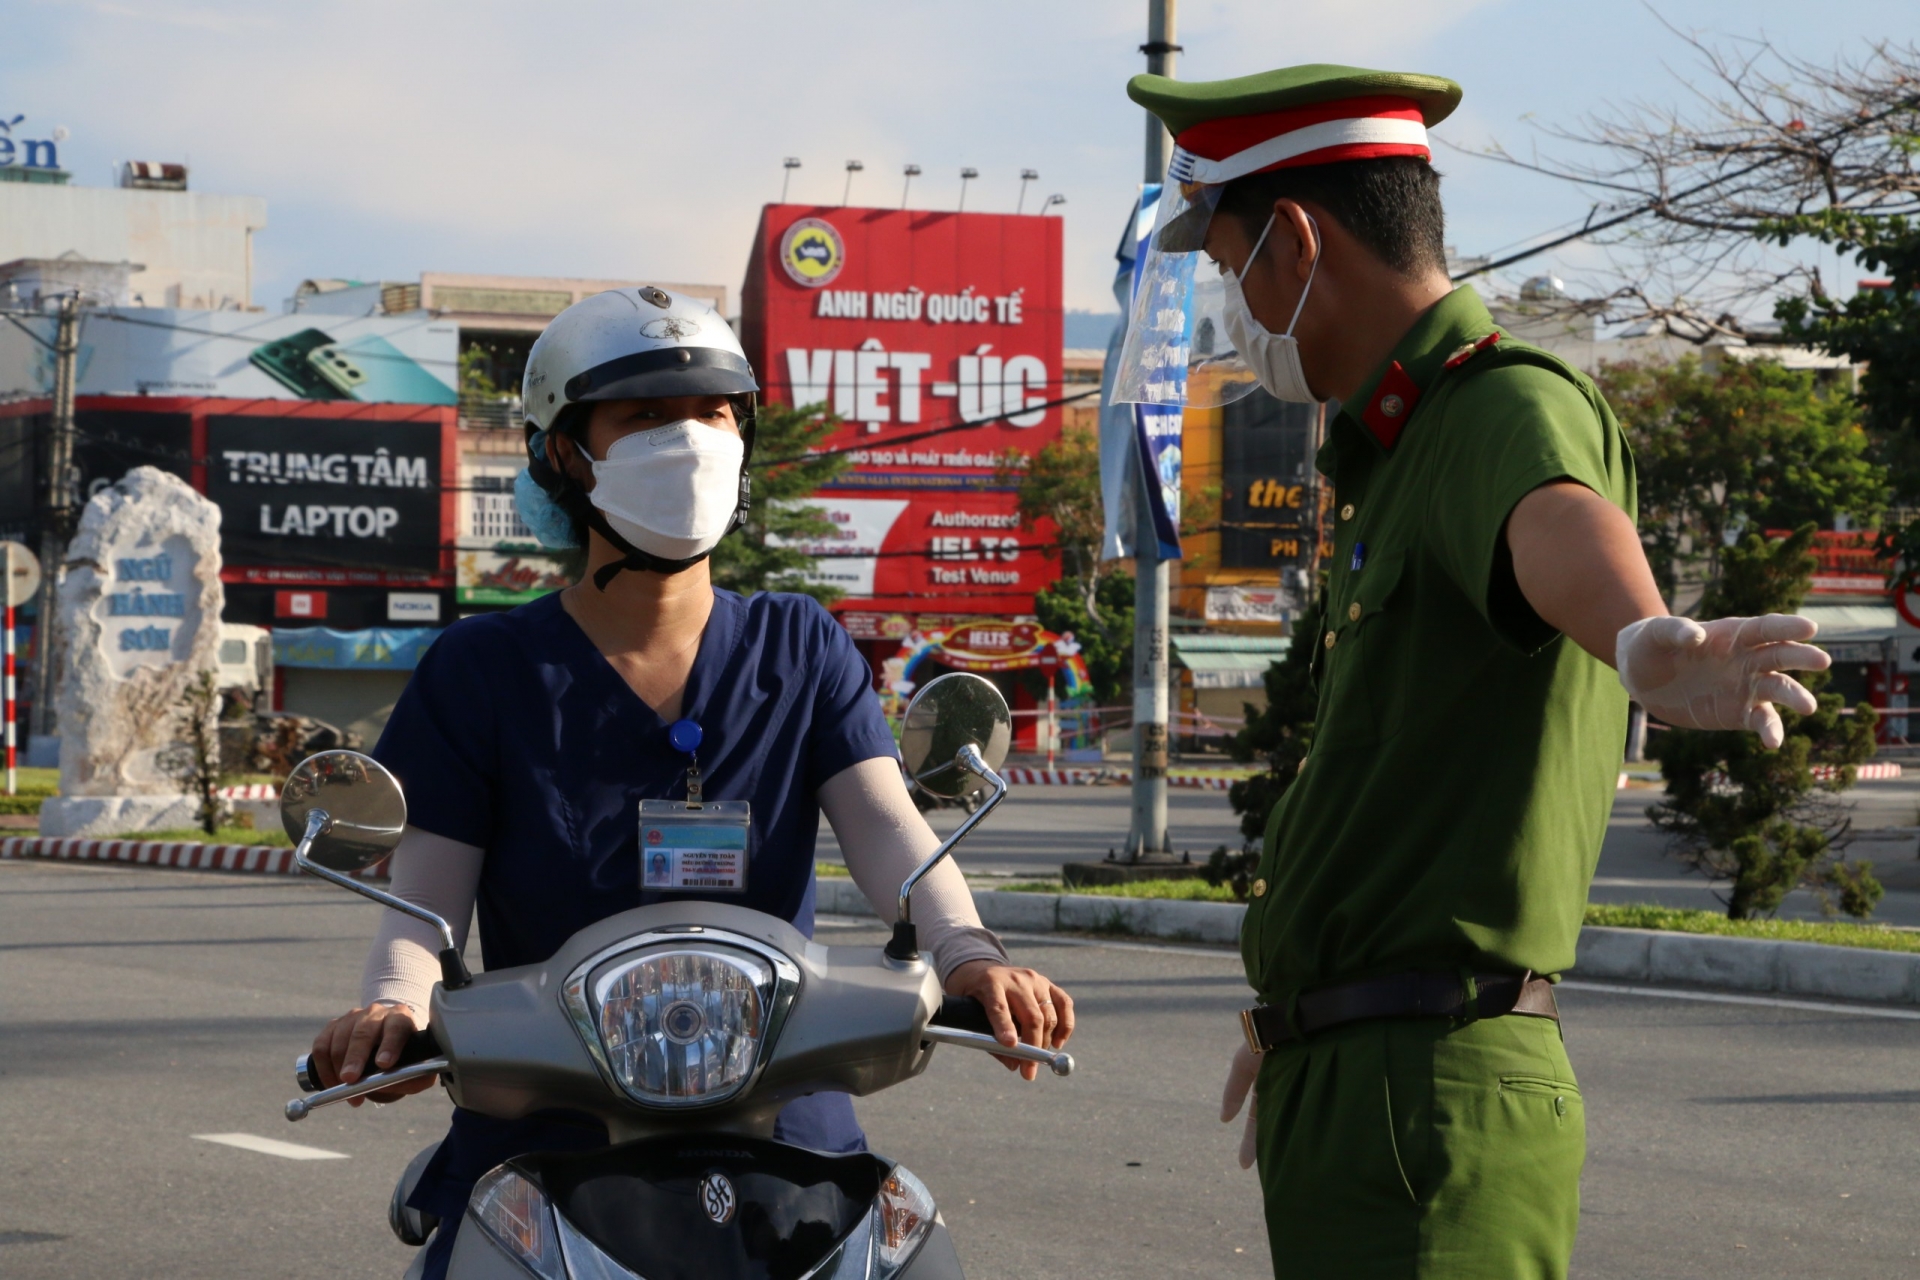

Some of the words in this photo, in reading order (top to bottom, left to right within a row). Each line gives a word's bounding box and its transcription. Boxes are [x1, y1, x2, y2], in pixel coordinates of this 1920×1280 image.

[818, 290, 867, 317] ANH
[927, 285, 989, 324] QUỐC
[995, 287, 1025, 324] TẾ
[895, 448, 909, 465] VÀ
[911, 449, 940, 466] PHÁT
[223, 451, 347, 484] TRUNG
[351, 447, 427, 488] TÂM
[260, 504, 398, 537] LAPTOP
[932, 511, 1020, 528] Authorized
[932, 537, 1019, 561] IELTS
[932, 566, 966, 583] Test
[970, 566, 1020, 584] Venue
[393, 602, 434, 612] NOKIA
[969, 631, 1010, 646] IELTS
